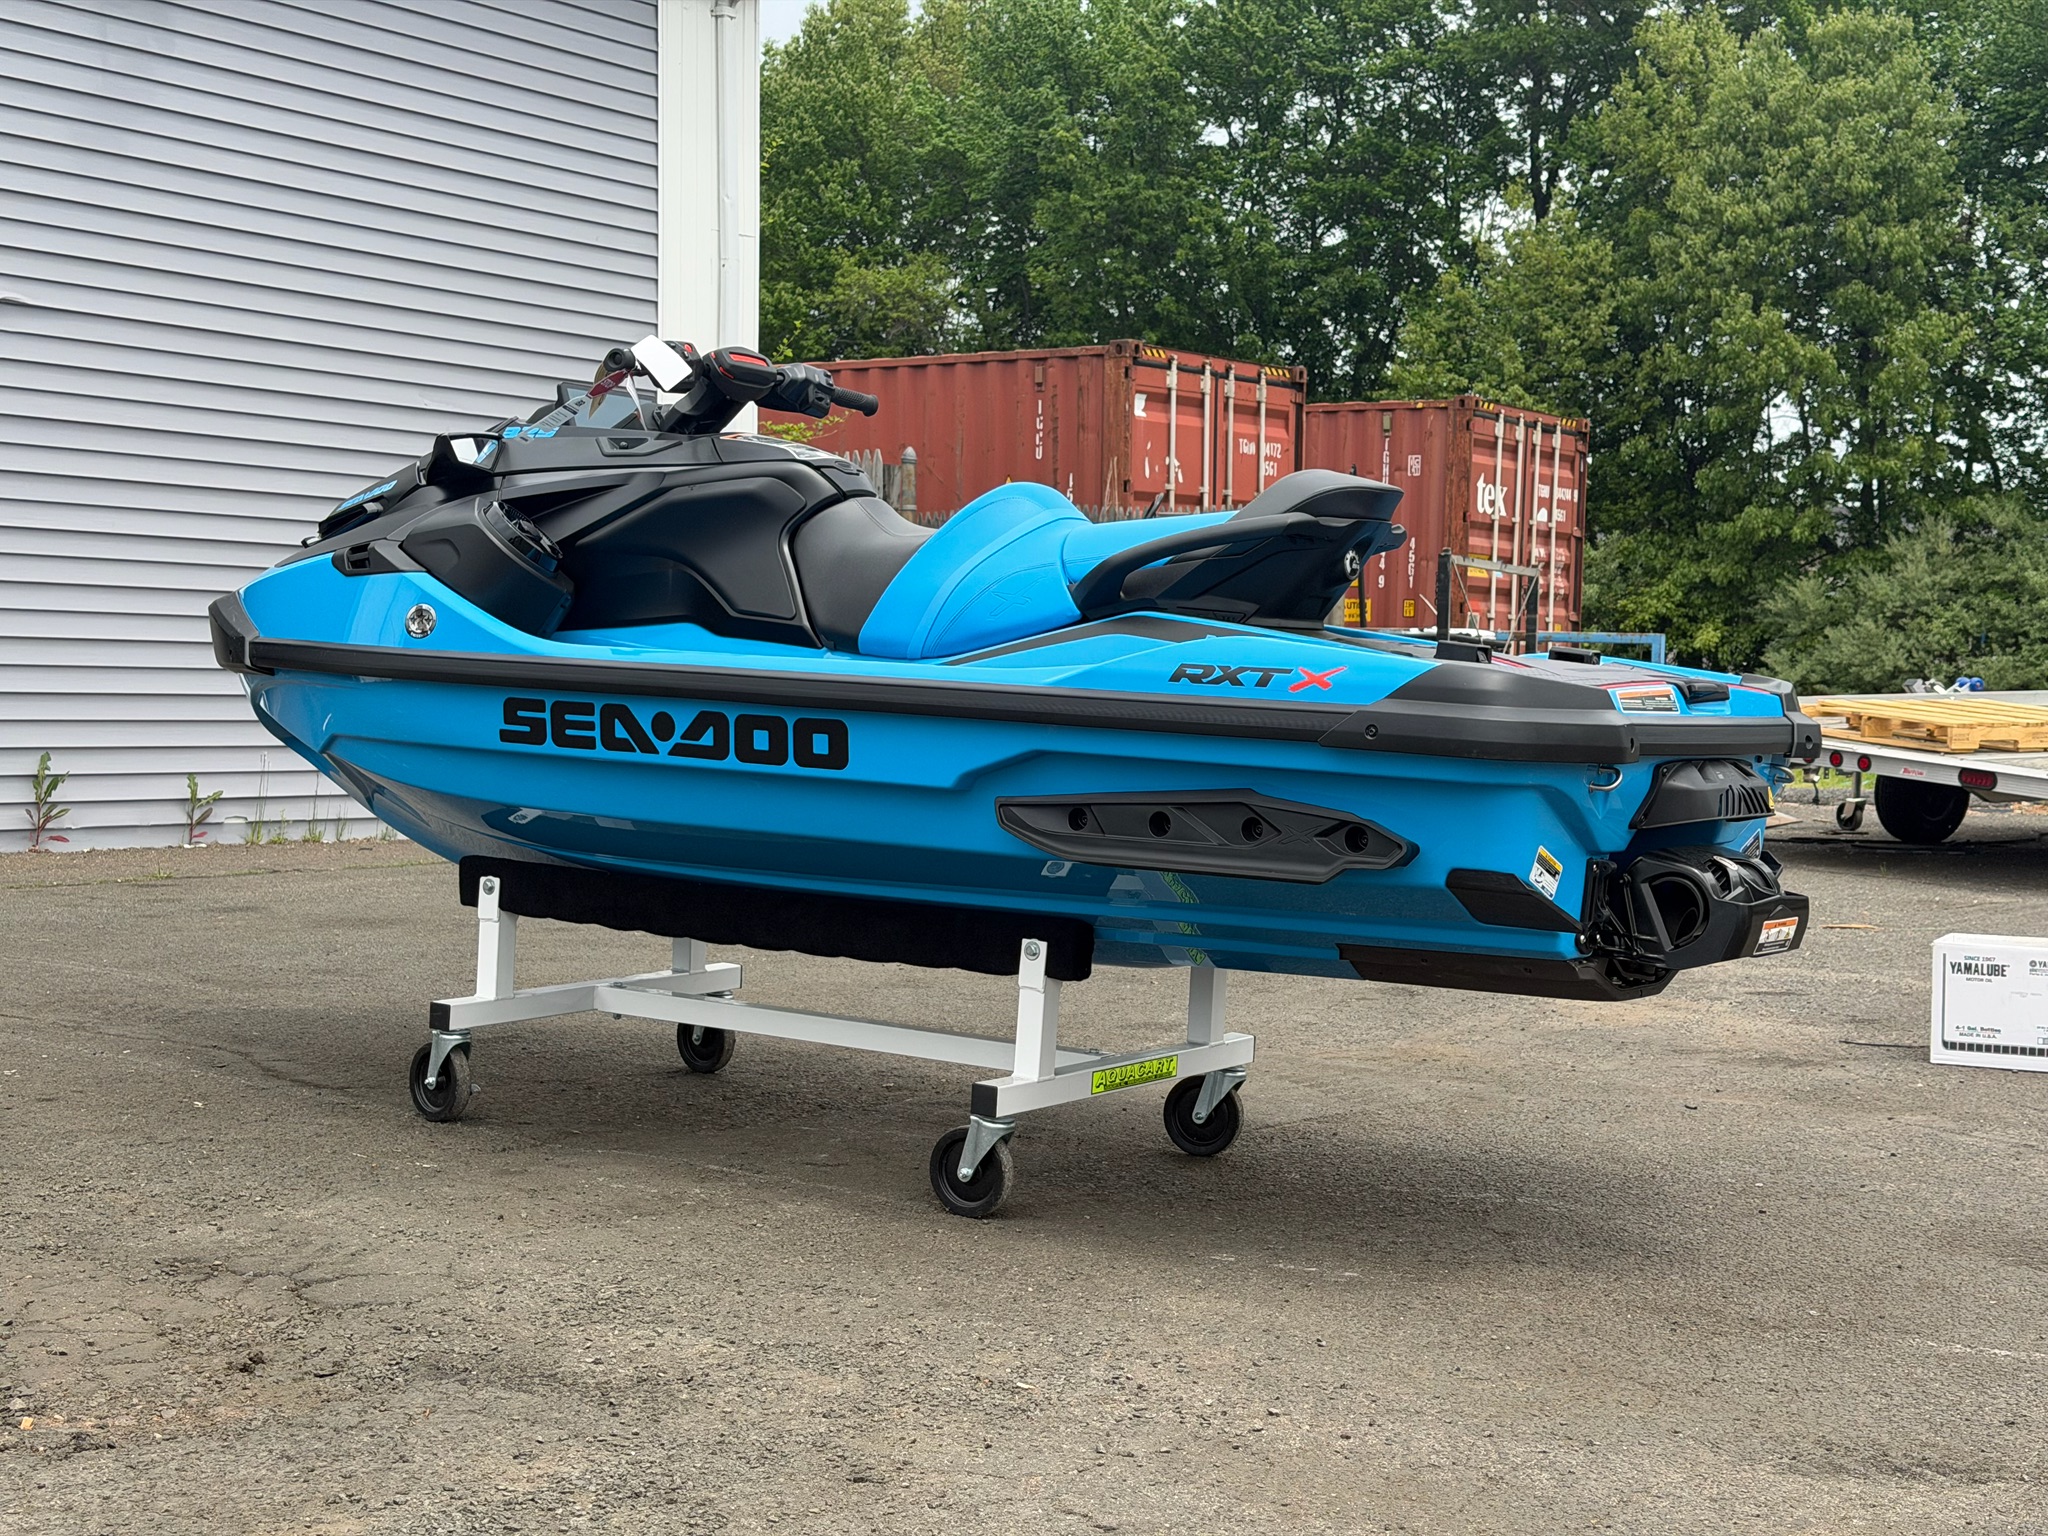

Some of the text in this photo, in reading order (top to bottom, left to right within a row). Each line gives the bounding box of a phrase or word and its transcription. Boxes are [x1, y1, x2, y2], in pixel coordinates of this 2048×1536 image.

[1476, 472, 1509, 518] tex
[1168, 663, 1294, 688] RXT
[1949, 961, 2008, 978] YAMALUBE
[1095, 1058, 1174, 1089] AQUACART
